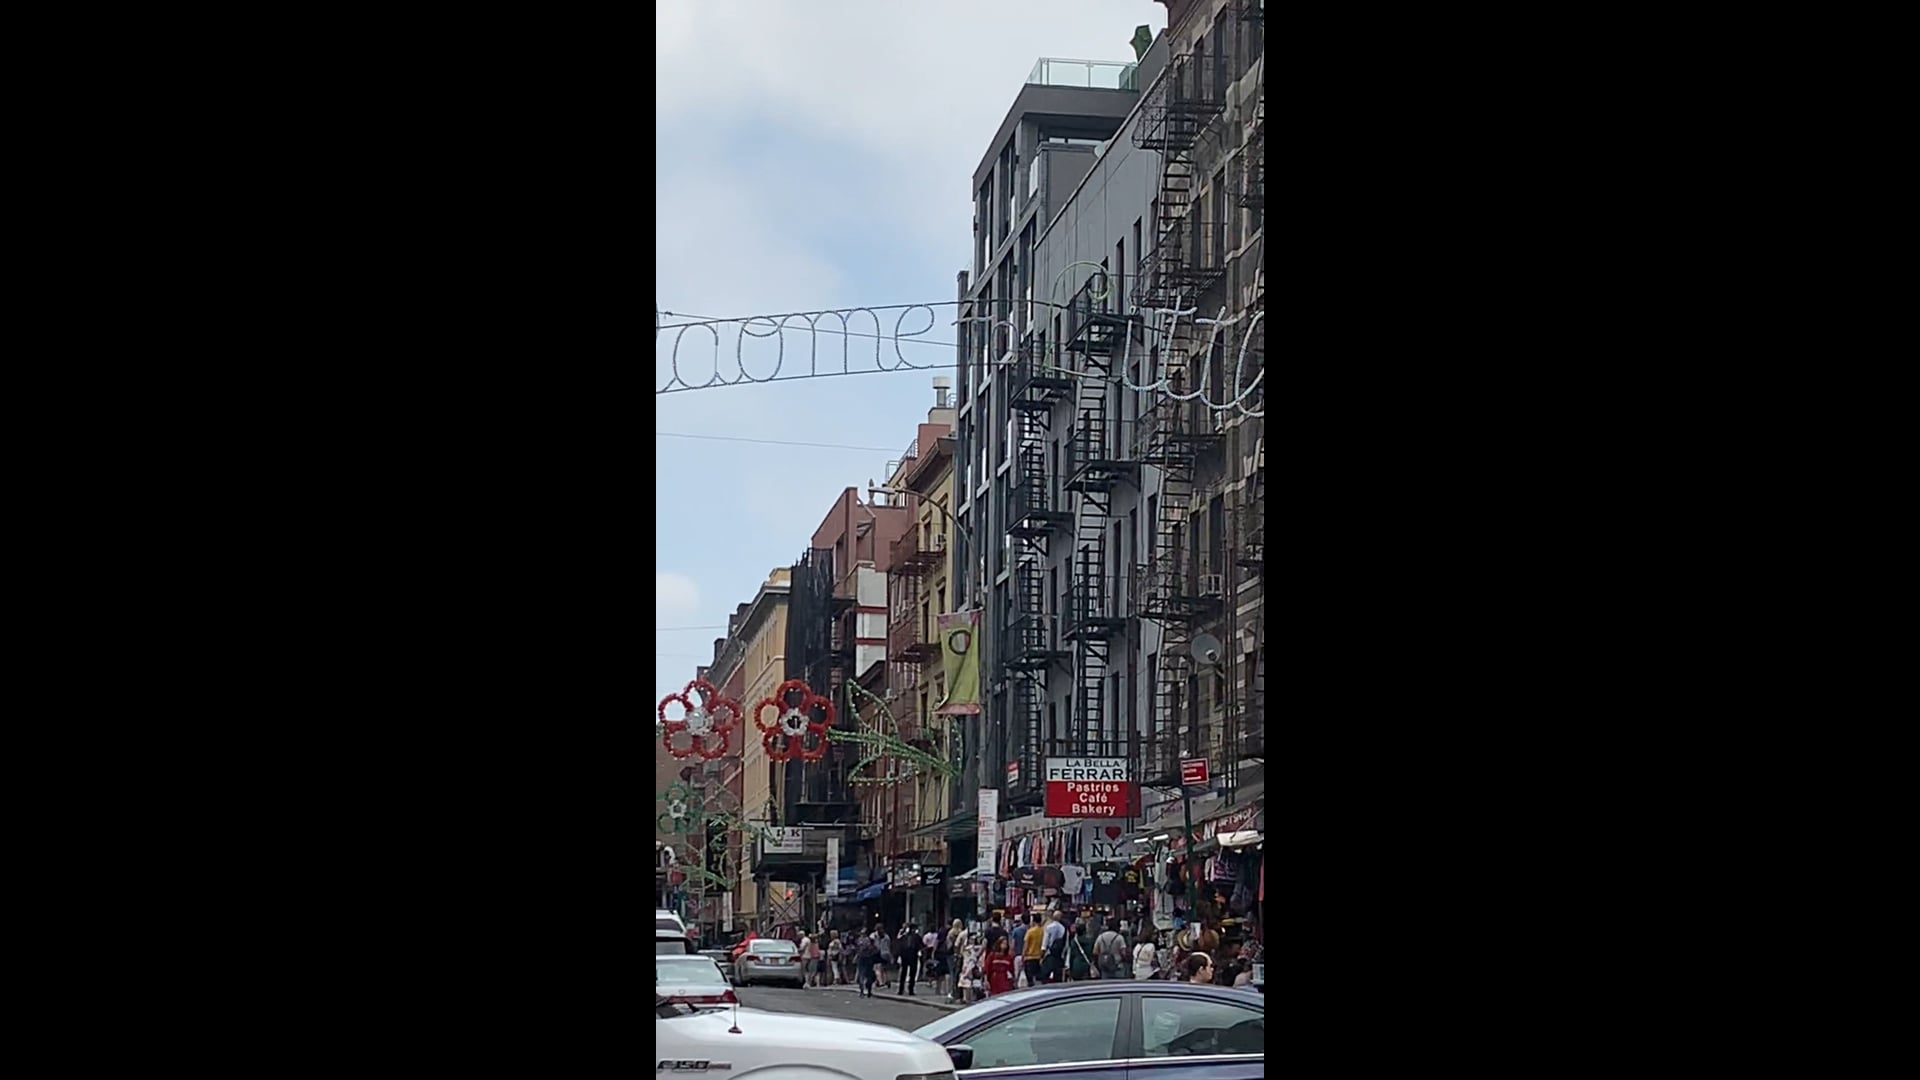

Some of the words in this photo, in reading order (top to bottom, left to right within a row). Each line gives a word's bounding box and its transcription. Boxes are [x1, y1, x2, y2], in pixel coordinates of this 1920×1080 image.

[1066, 759, 1080, 767] LA
[1084, 759, 1120, 768] BELLA
[1067, 782, 1119, 793] Pastries
[1079, 792, 1107, 803] Café
[1072, 803, 1115, 816] Bakery
